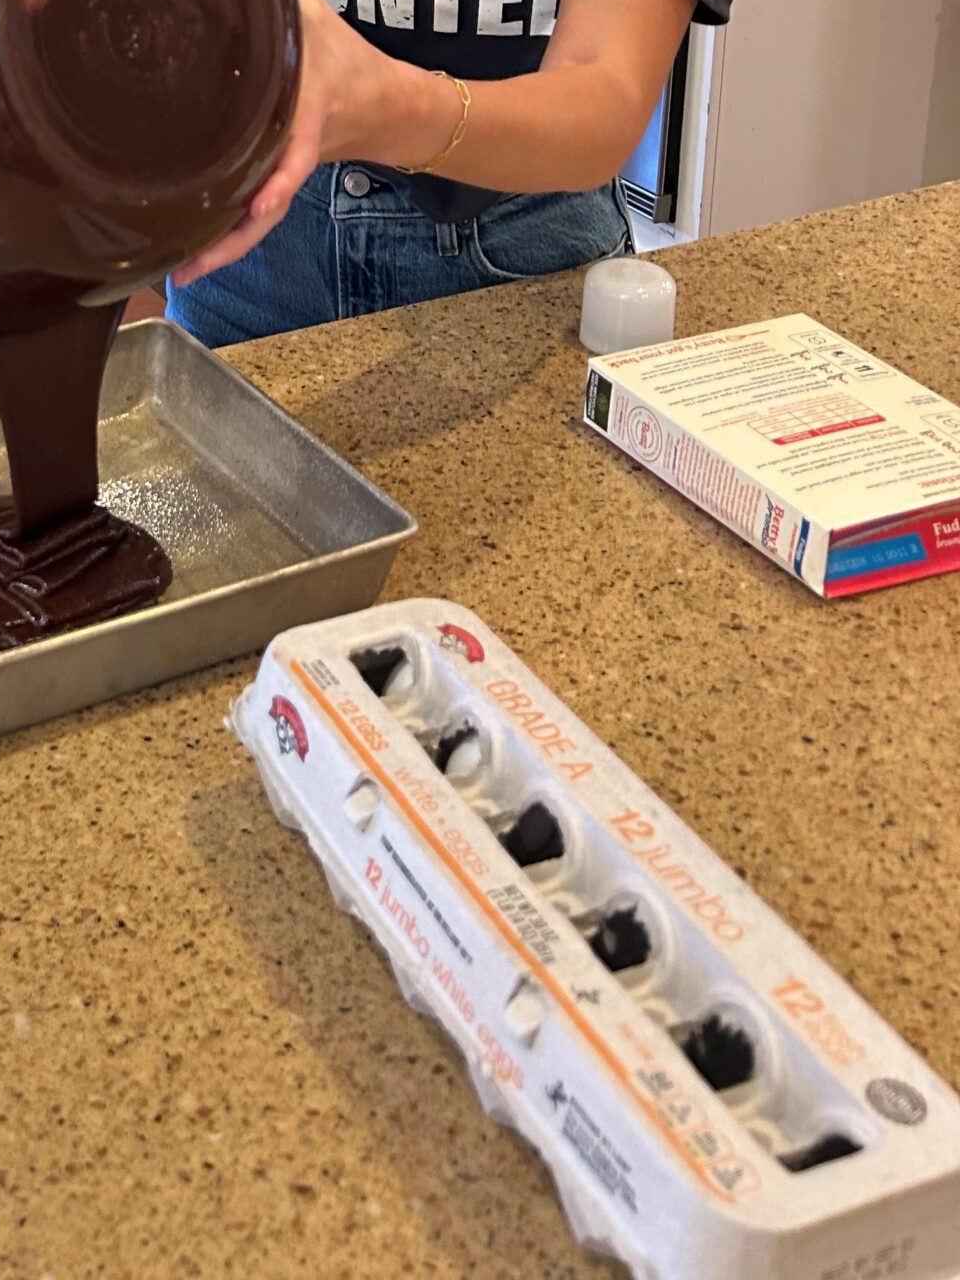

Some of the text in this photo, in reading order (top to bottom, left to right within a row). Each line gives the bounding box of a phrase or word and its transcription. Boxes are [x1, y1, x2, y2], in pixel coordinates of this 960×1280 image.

[336, 699, 390, 753] 12 EGGS
[485, 679, 595, 782] GRADE A
[394, 766, 440, 813] white
[443, 828, 489, 877] eggs
[608, 807, 656, 844] 12
[631, 843, 745, 942] jumbo
[365, 855, 384, 890] 12
[379, 885, 431, 959] jumbo
[431, 955, 476, 1024] white
[477, 1022, 525, 1091] eggs
[769, 975, 826, 1018] 12
